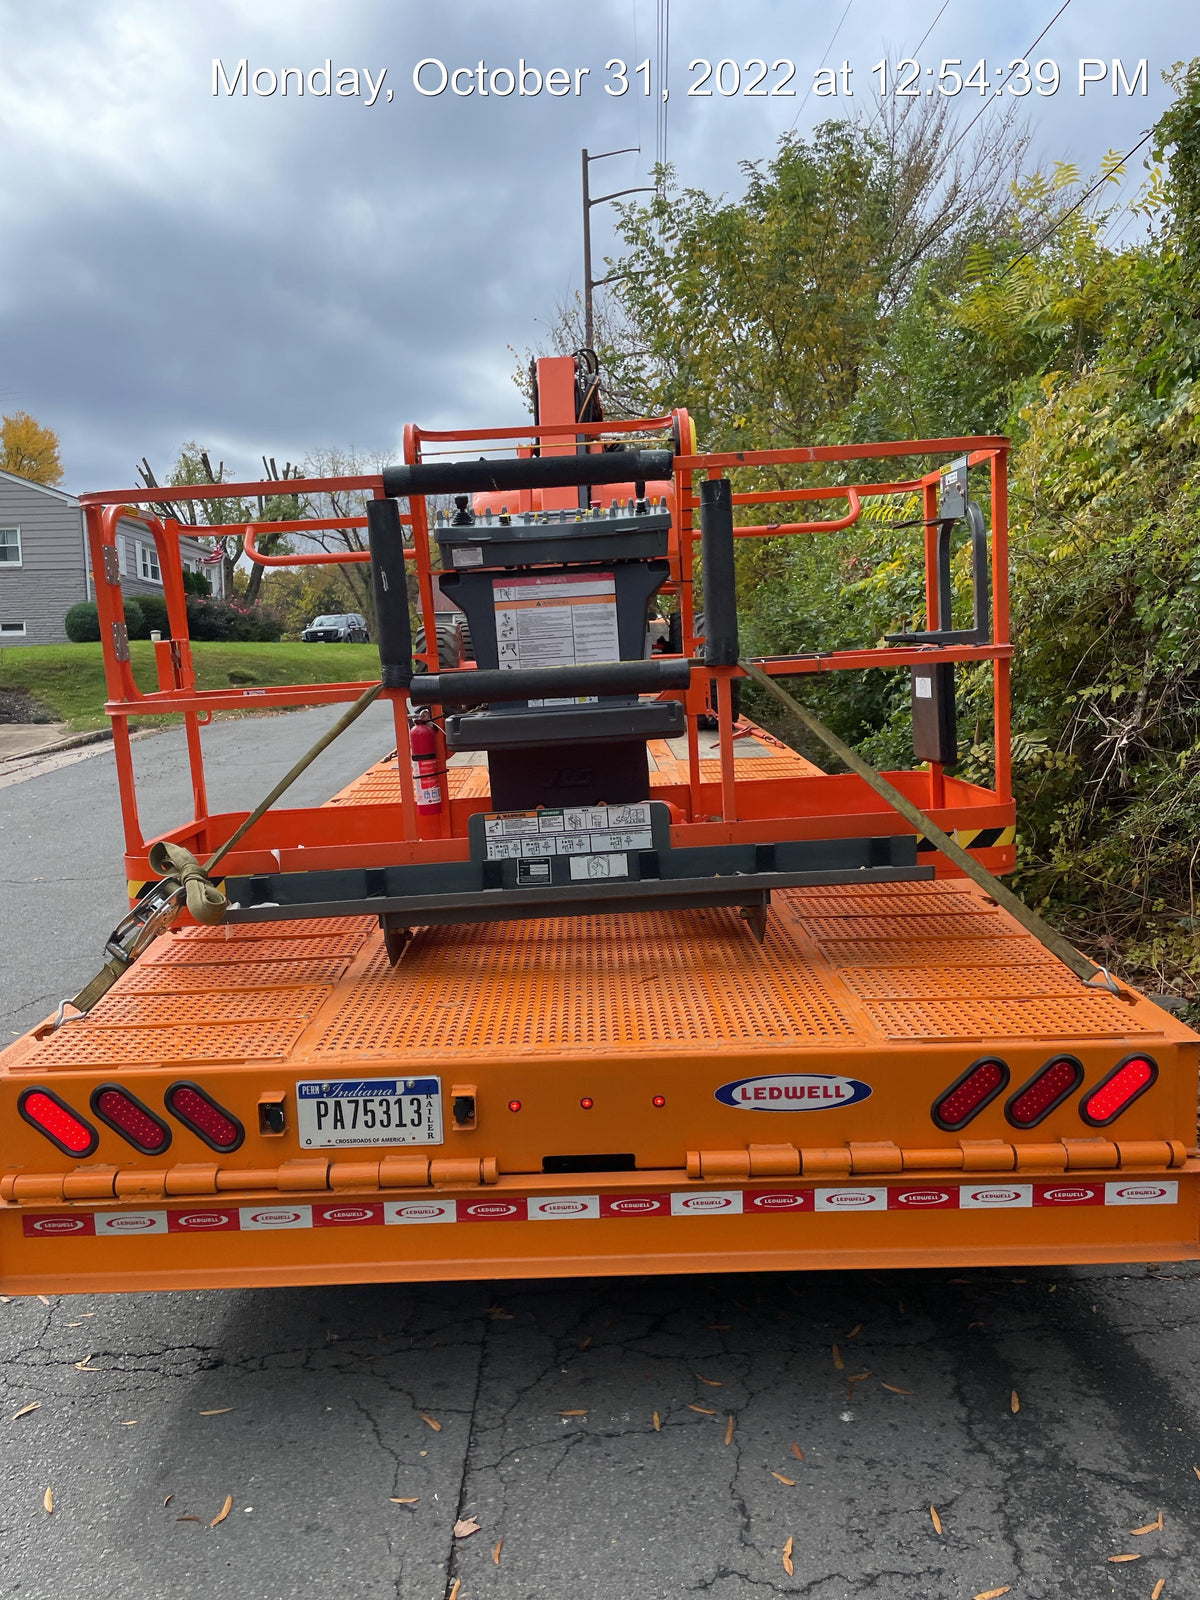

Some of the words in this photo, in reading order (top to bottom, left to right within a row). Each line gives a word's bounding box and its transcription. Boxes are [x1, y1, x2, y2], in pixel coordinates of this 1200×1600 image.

[329, 1081, 393, 1098] Indiana
[741, 1085, 845, 1101] LEDWELL
[316, 1097, 423, 1131] PA75313
[425, 1084, 435, 1140] TRAILER
